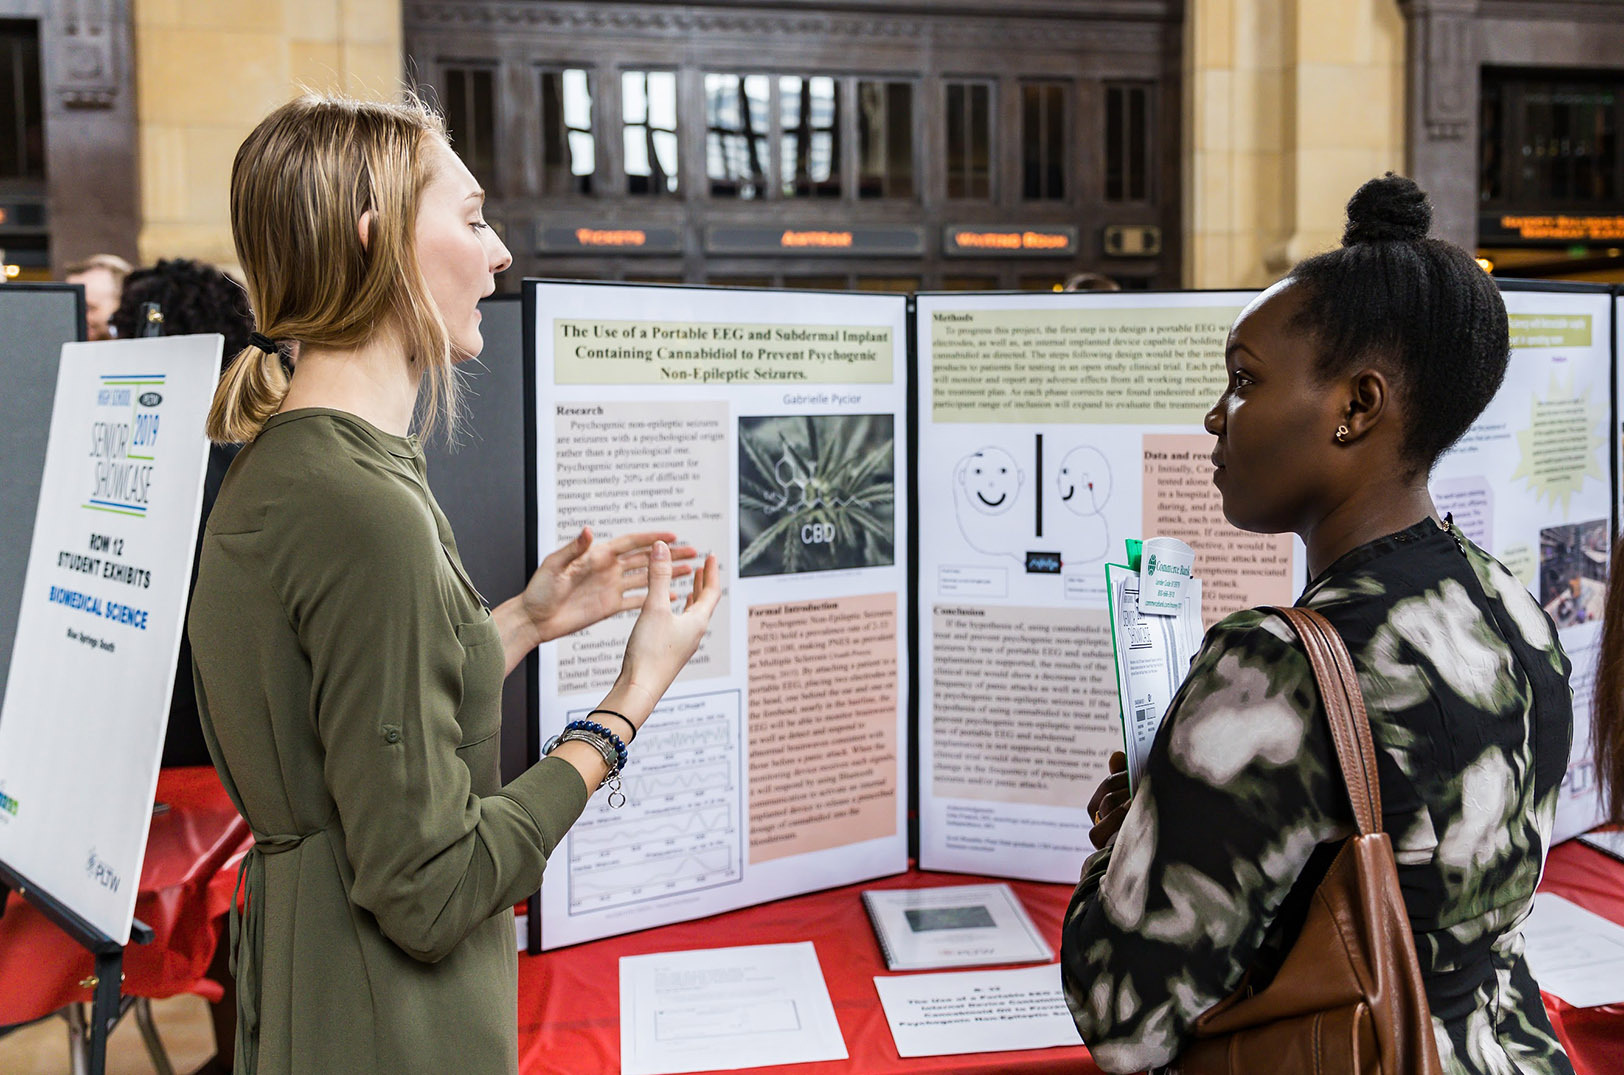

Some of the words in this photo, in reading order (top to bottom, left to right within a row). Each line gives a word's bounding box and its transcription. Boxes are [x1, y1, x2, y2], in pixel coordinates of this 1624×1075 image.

[933, 314, 973, 322] Methods
[561, 325, 588, 338] The
[593, 325, 618, 338] Use
[623, 326, 636, 339] of
[640, 330, 647, 339] a
[652, 327, 708, 340] Portable
[713, 328, 743, 340] EEG
[748, 329, 771, 340] and
[775, 329, 839, 342] Subdermal
[843, 330, 888, 345] Implant
[575, 346, 652, 361] Containing
[657, 347, 737, 360] Cannabidiol
[741, 349, 753, 360] to
[758, 348, 803, 360] Prevent
[808, 349, 876, 364] Psychogenic
[660, 367, 749, 382] Non-Epileptic
[754, 368, 807, 380] Seizures.
[557, 407, 604, 415] Research
[89, 422, 129, 459] SENIOR
[134, 415, 160, 447] 2019
[1144, 452, 1167, 460] Data
[1171, 452, 1189, 460] and
[93, 462, 153, 504] SHOWCASE
[801, 523, 835, 545] CBD
[89, 533, 110, 553] ROW
[113, 539, 124, 556] 12
[58, 551, 101, 575] STUDENT
[103, 561, 151, 589] EXHIBITS
[1156, 560, 1180, 574] Commerce
[1180, 564, 1190, 576] Bank
[50, 586, 102, 616] BIOMEDICAL
[106, 601, 148, 630] SCIENCE
[749, 607, 781, 617] Formal
[784, 602, 838, 613] Introduction
[933, 607, 985, 616] Conclusion
[95, 862, 121, 893] PLTW
